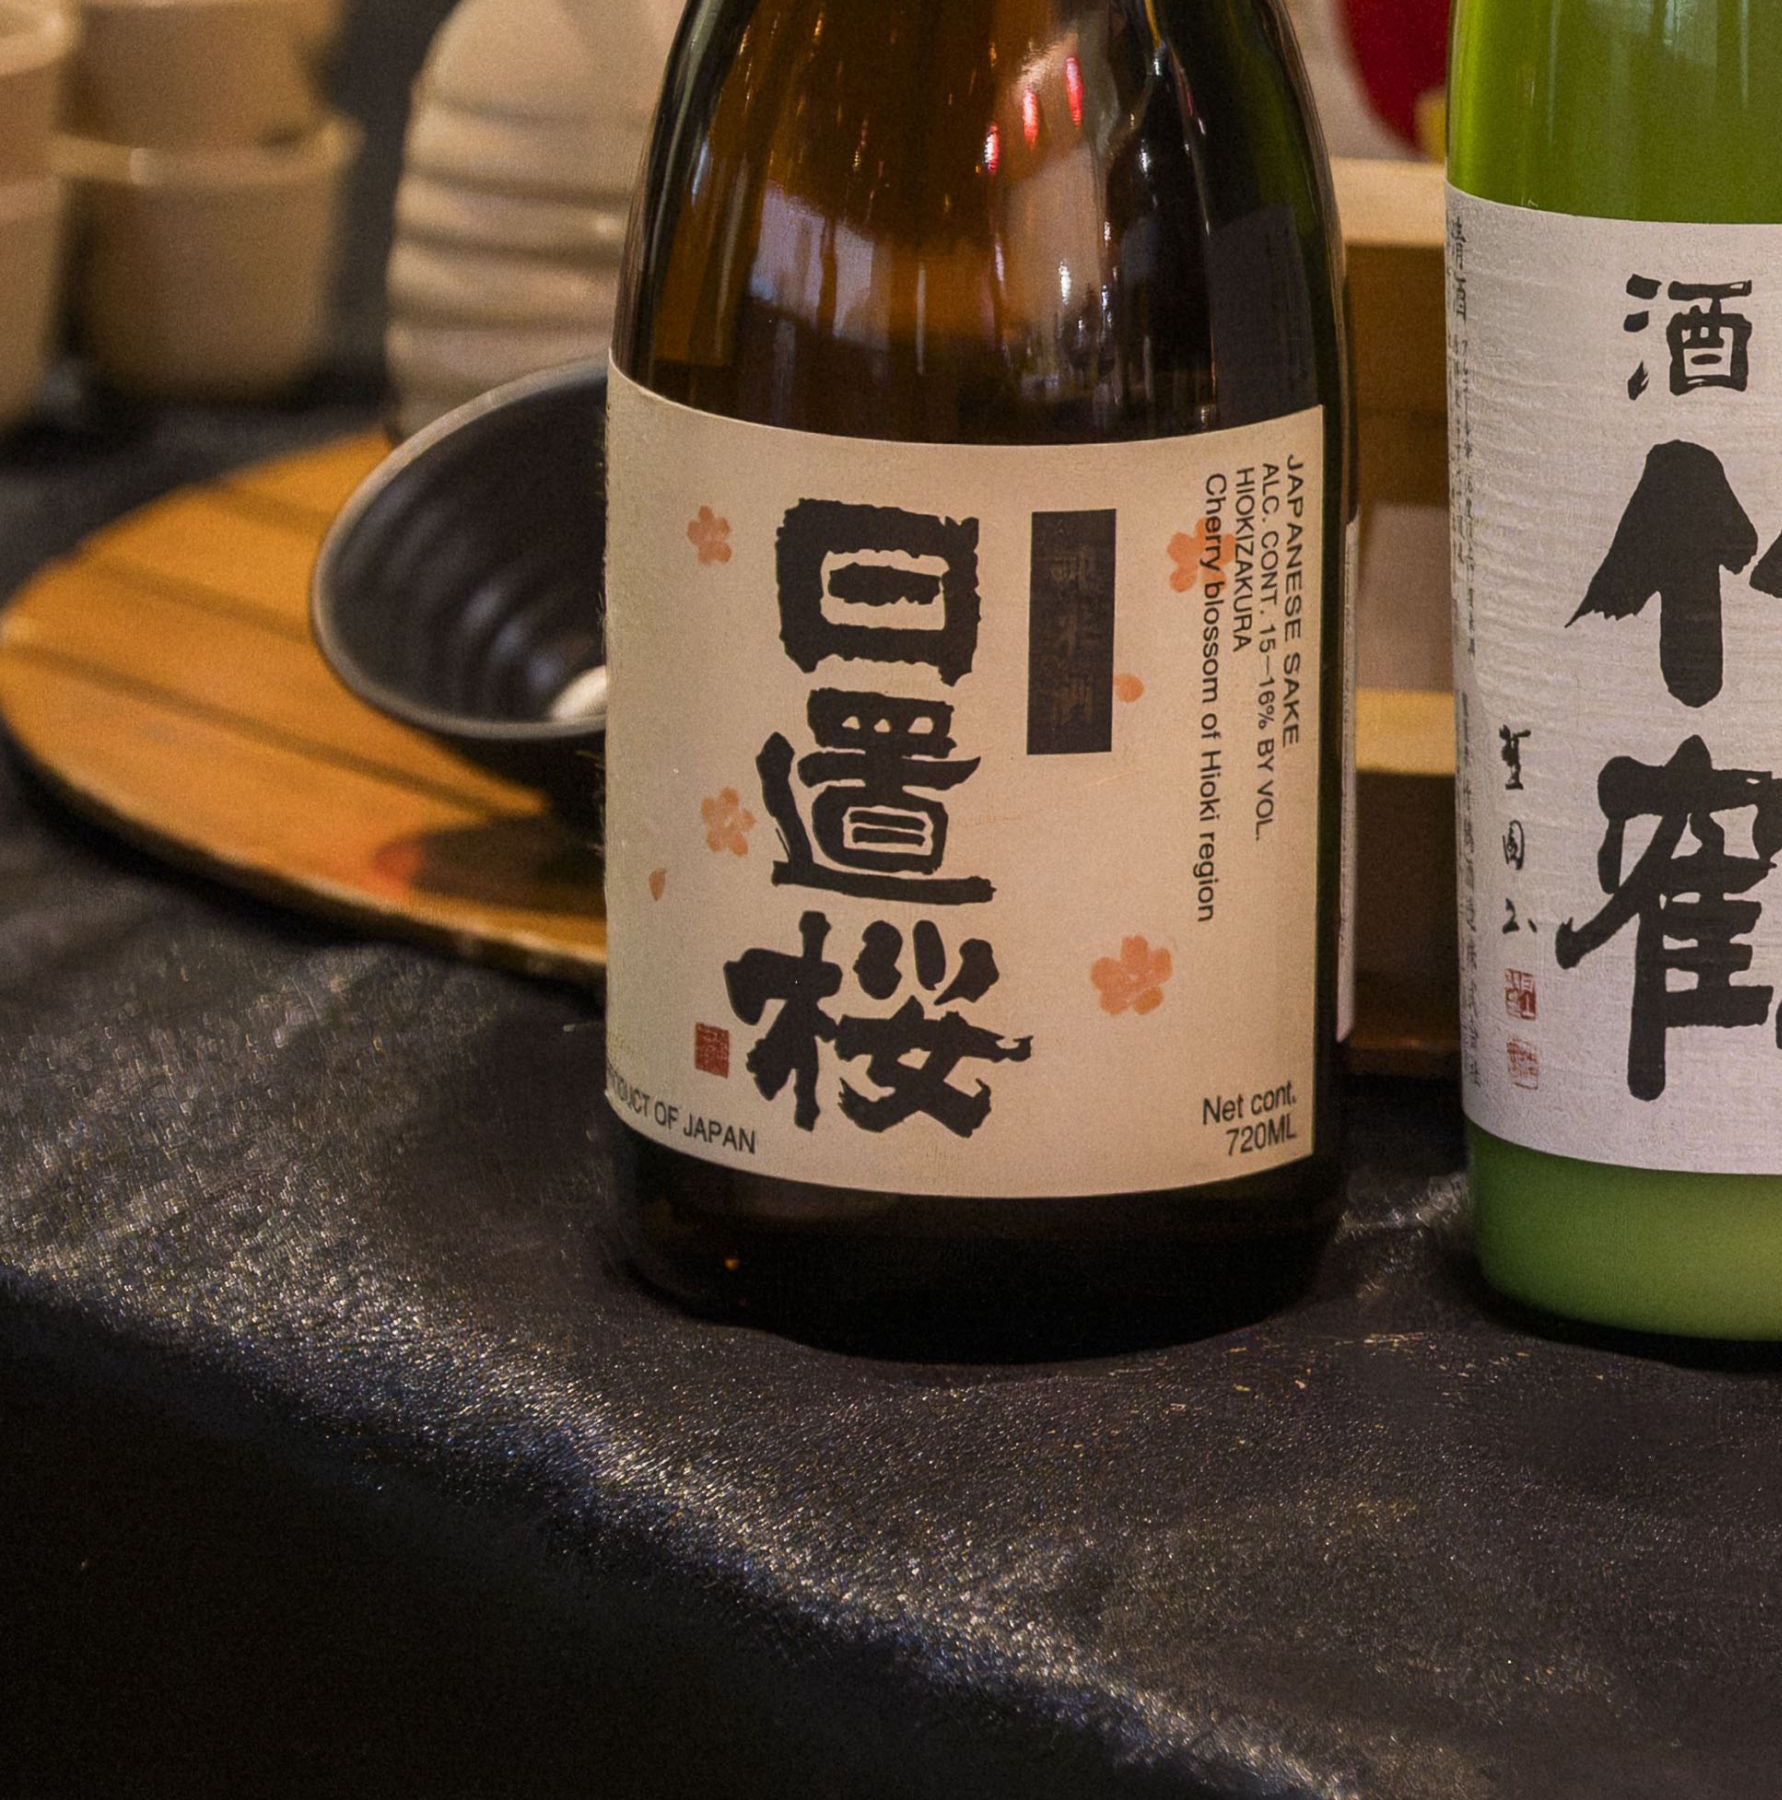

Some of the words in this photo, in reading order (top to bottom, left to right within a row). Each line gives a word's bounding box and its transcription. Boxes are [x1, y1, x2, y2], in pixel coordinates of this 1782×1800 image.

[1200, 472, 1228, 572] Cherry
[1261, 462, 1280, 523] ALC.
[1233, 466, 1256, 653] HIOKIZAKURA
[1259, 530, 1280, 616] CONT.
[1284, 453, 1305, 643] JAPANESE
[1202, 581, 1225, 703] blossom
[1201, 712, 1222, 740] of
[1282, 651, 1301, 748] SAKE
[1199, 749, 1222, 822] Hioki
[1256, 738, 1275, 773] BY
[1255, 779, 1274, 842] VOL.
[1192, 831, 1219, 923] region
[653, 1100, 680, 1131] OF
[682, 1112, 756, 1155] JAPAN
[1202, 1094, 1244, 1126] Net
[1250, 1079, 1297, 1116] cont.
[1225, 1112, 1297, 1157] 720ML
